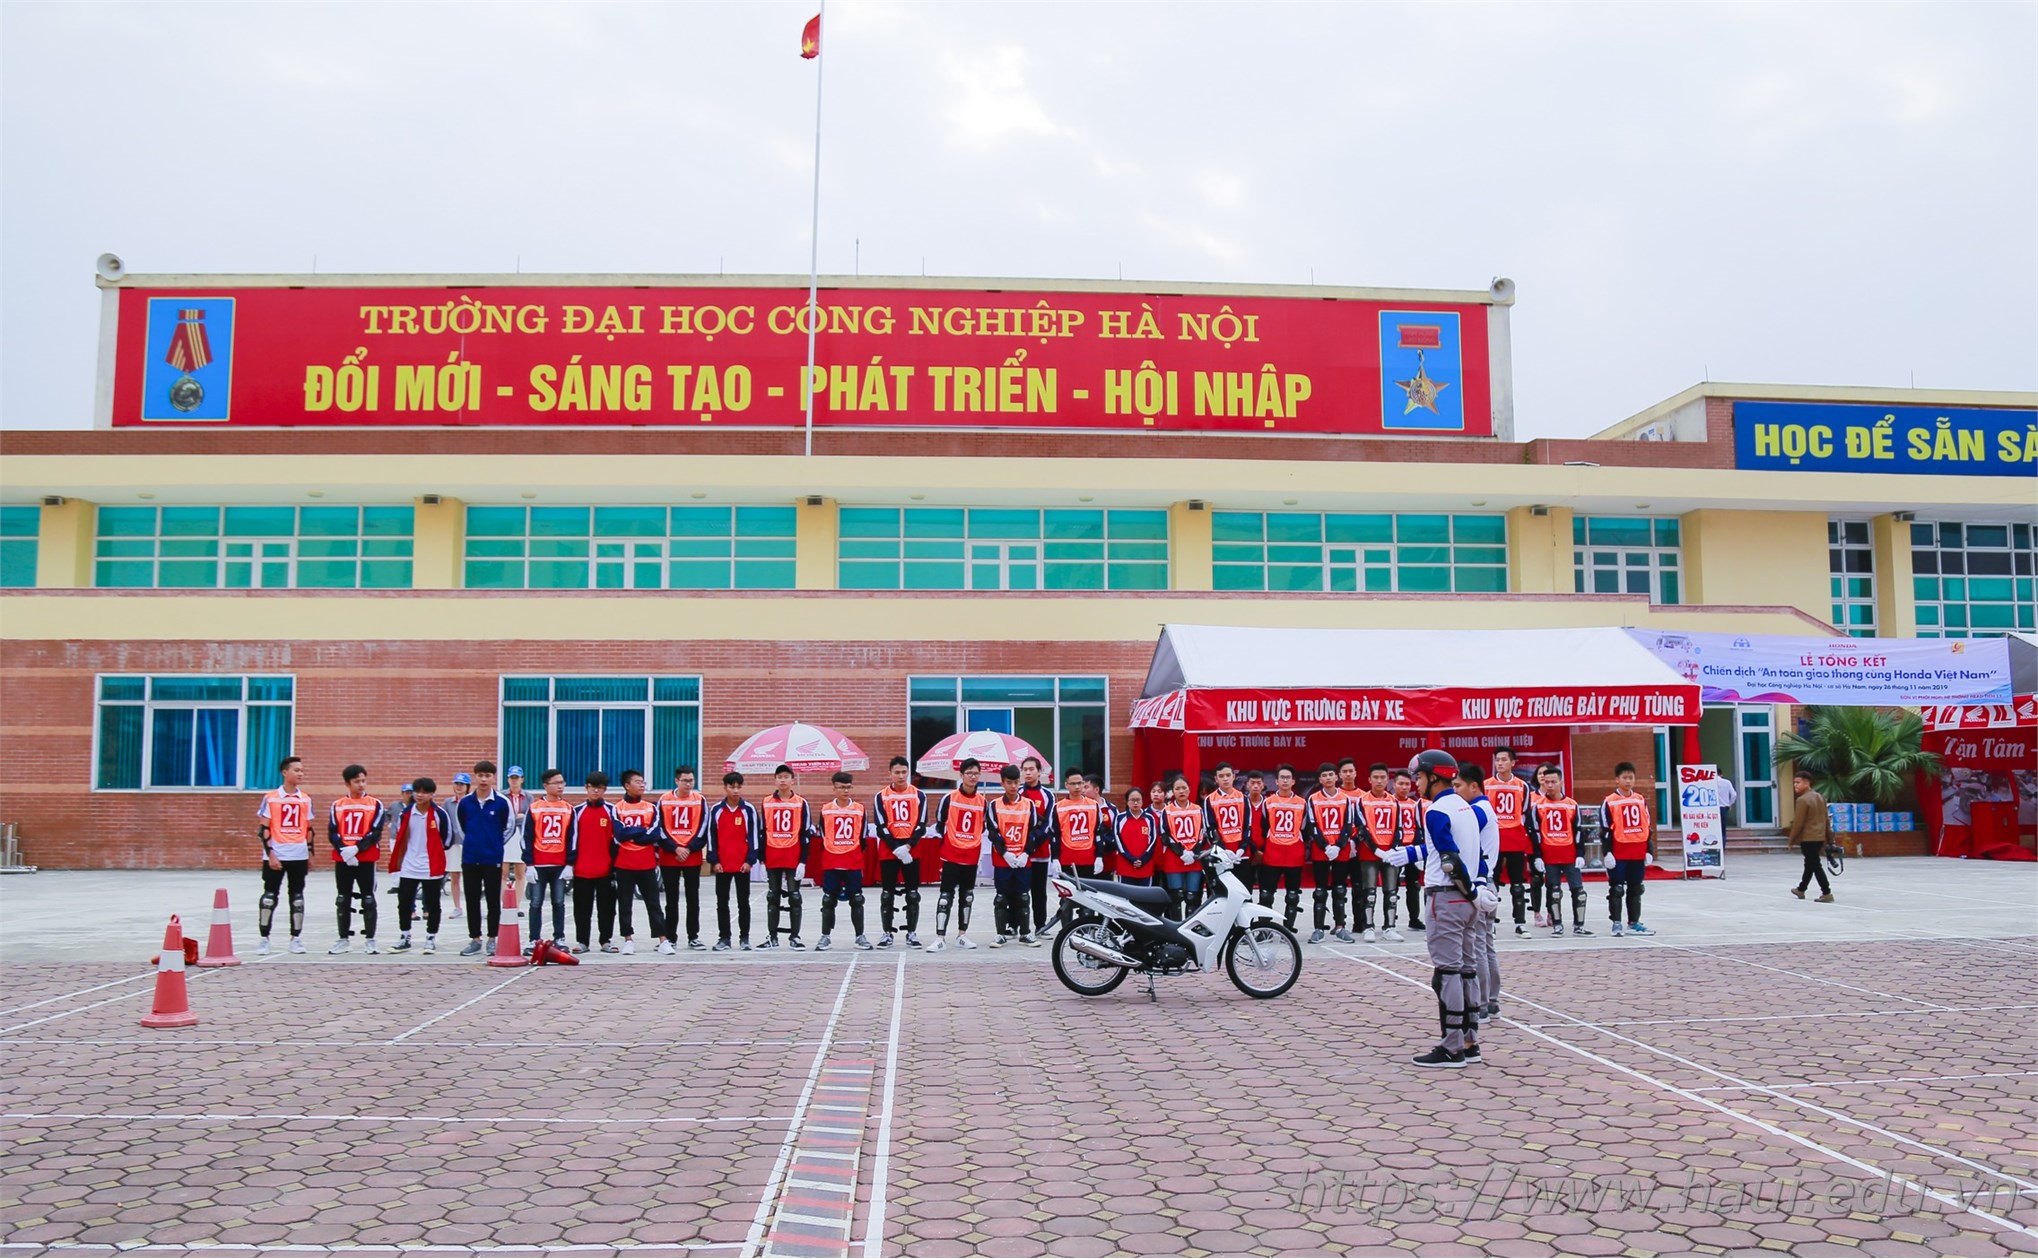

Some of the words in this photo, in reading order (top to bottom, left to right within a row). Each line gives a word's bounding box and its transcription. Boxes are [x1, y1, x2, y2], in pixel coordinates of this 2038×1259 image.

[360, 295, 549, 336] TRƯỜNG
[561, 303, 645, 341] ĐẠI
[658, 305, 755, 342] HỌC
[766, 300, 897, 336] CÔNG
[908, 300, 1085, 345] NGHIỆP
[1098, 302, 1165, 340] HÀ
[1177, 305, 1260, 349] NỘI
[303, 346, 379, 412] ĐỔI
[395, 350, 481, 412] MỚI
[496, 383, 513, 396] -
[528, 354, 652, 412] SÁNG
[666, 364, 752, 421] TẠO
[767, 384, 785, 397] -
[801, 355, 915, 412] PHÁT
[927, 347, 1058, 414] TRIỂN
[1072, 387, 1090, 400] -
[1104, 360, 1180, 425] HỘI
[1193, 363, 1312, 428] NHẬP
[1754, 423, 1834, 465] HỌC
[1845, 413, 1896, 461] ĐỂ
[1907, 416, 1987, 462] SẴN
[1863, 653, 1887, 667] KẾT
[1734, 666, 1756, 679] dịch
[1805, 668, 1830, 681] giao
[1894, 669, 1932, 680] Honda
[1934, 669, 1958, 682] Việt
[1226, 700, 1258, 723] KHU
[1261, 697, 1292, 726] VỰC
[1295, 697, 1347, 722] TRƯNG
[1350, 695, 1381, 721] BÀY
[1385, 699, 1405, 721] XE
[1461, 698, 1491, 720] KHU
[1494, 695, 1523, 723] VỰC
[1526, 694, 1574, 718] TRƯNG
[1576, 691, 1608, 716] BÀY
[1608, 695, 1640, 721] PHỤ
[1643, 690, 1685, 718] TÙNG
[1216, 735, 1237, 749] VỰC
[1239, 735, 1271, 748] TRƯNG
[1273, 735, 1293, 748] BÀY
[1294, 736, 1307, 748] XE
[1399, 737, 1418, 751] PHỤ
[1448, 737, 1479, 748] HONDA
[1481, 734, 1510, 748] CHÍNH
[1513, 735, 1534, 748] HIỆU
[1944, 735, 1978, 762] Tận
[1982, 737, 2026, 759] Tâm
[1681, 767, 1716, 784] SALE
[891, 801, 909, 822] 16
[1496, 792, 1514, 814] 30
[282, 804, 300, 827] 21
[345, 811, 364, 834] 17
[542, 815, 562, 838] 25
[672, 806, 690, 829] 14
[773, 809, 791, 832] 18
[962, 811, 973, 833] 6
[1069, 812, 1089, 836] 22
[1219, 806, 1239, 829] 29
[1275, 810, 1294, 832] 28
[1322, 808, 1339, 829] 12
[1375, 807, 1392, 829] 27
[1546, 810, 1563, 831] 13
[1623, 805, 1641, 827] 19
[835, 817, 854, 840] 26
[1005, 826, 1022, 842] 45
[1174, 817, 1194, 839] 20
